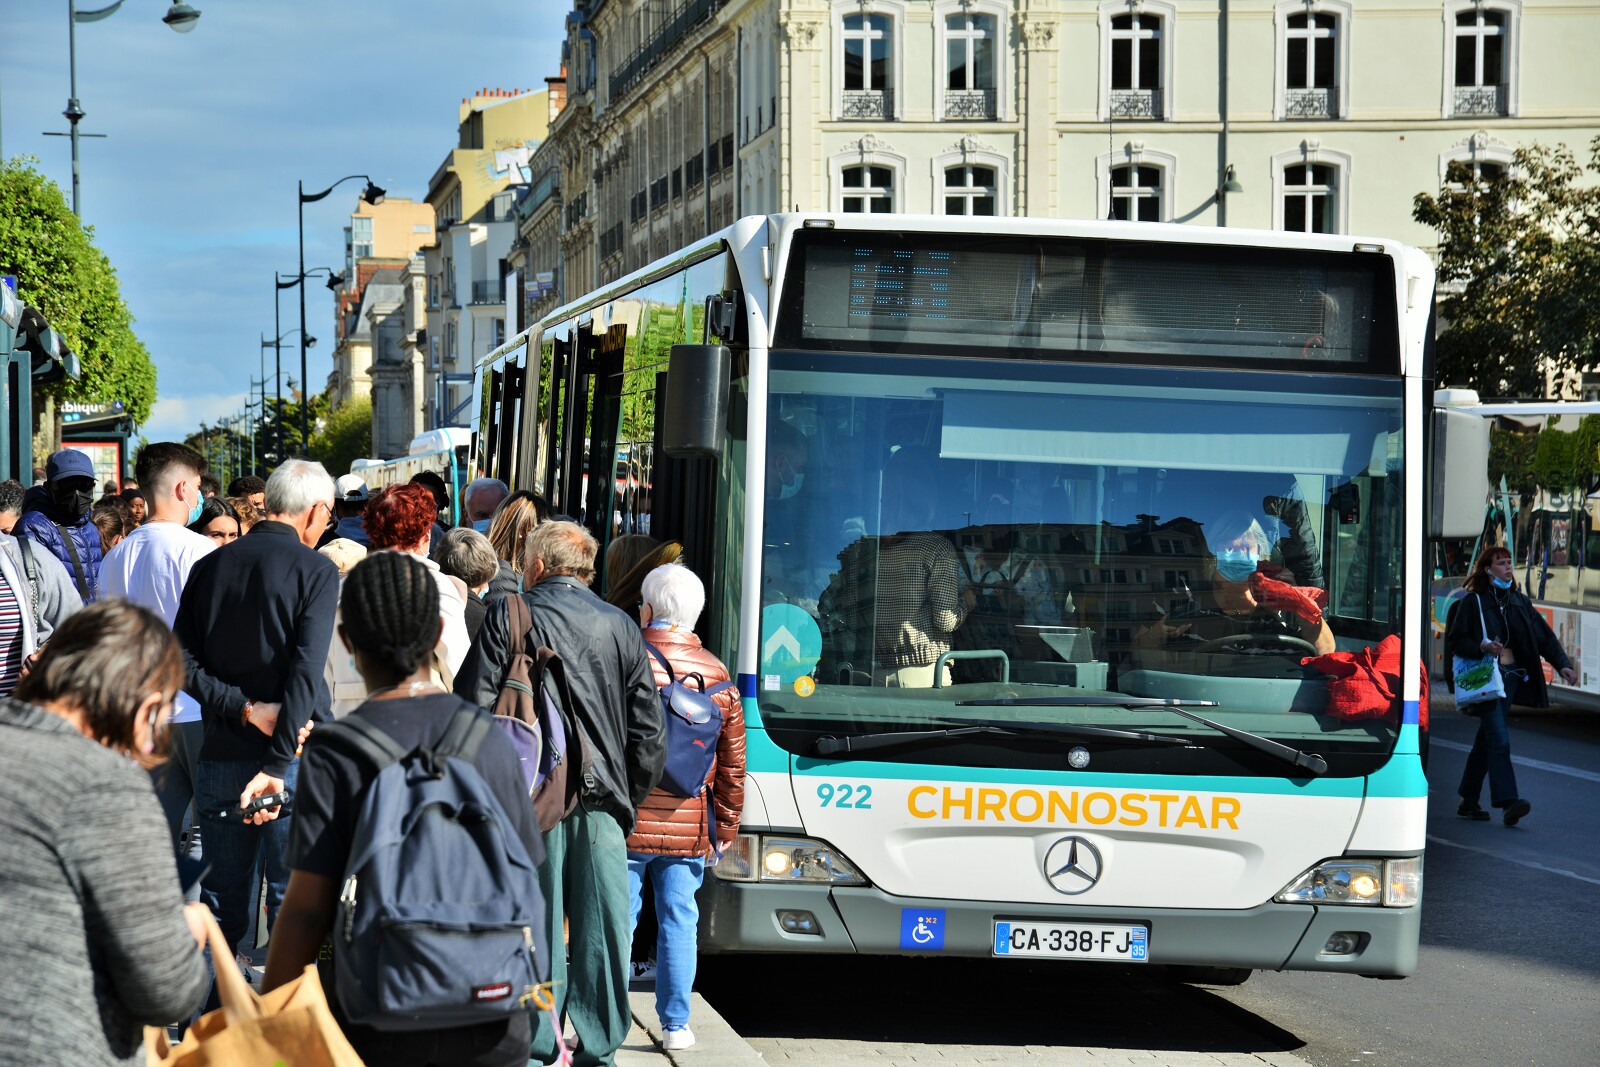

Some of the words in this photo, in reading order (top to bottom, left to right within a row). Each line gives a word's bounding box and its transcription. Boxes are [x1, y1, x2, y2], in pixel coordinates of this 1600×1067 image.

[816, 783, 873, 809] 922
[907, 785, 1242, 830] CHRONOSTAR
[1011, 928, 1131, 954] CA-338-FJ
[1132, 945, 1145, 957] 35
